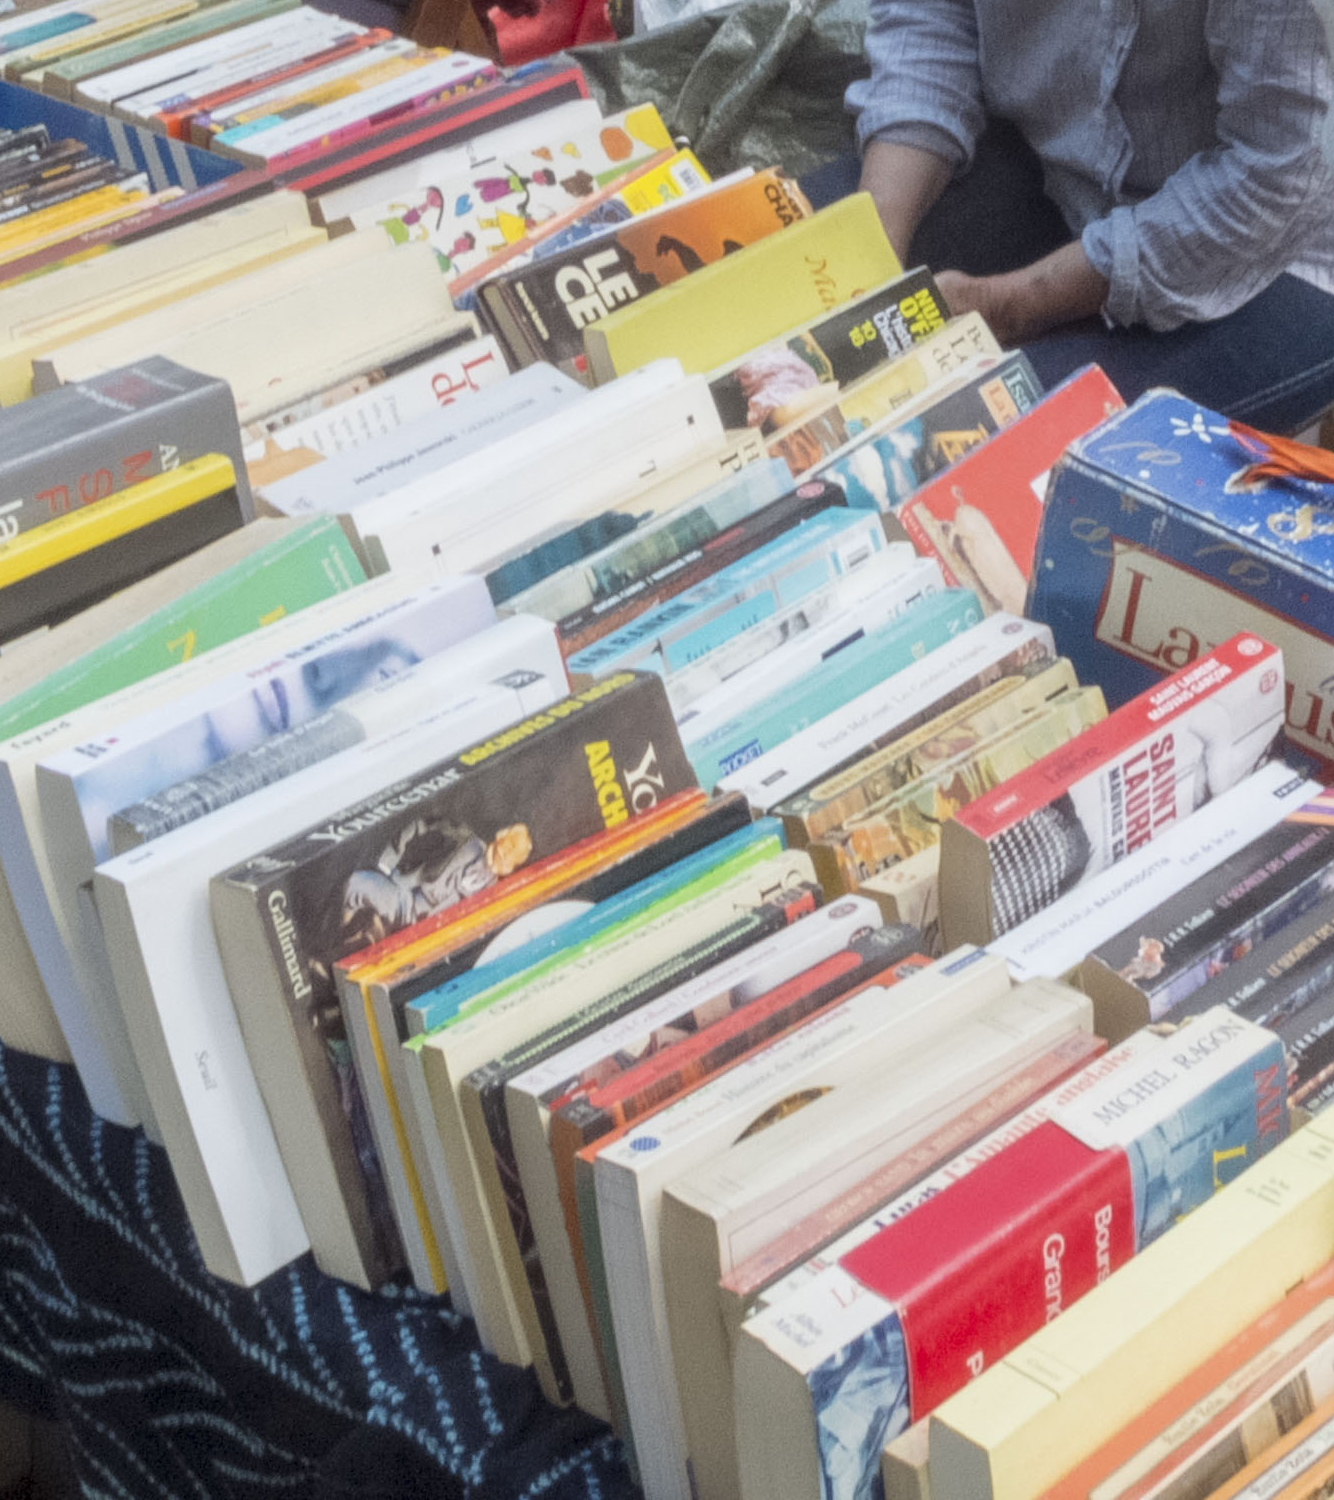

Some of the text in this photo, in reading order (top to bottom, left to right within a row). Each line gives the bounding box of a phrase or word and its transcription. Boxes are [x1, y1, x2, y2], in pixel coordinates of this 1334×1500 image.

[1149, 732, 1177, 829] SAINT
[268, 889, 309, 1001] Gallimard
[1091, 1017, 1247, 1128] MICHEL RAGON
